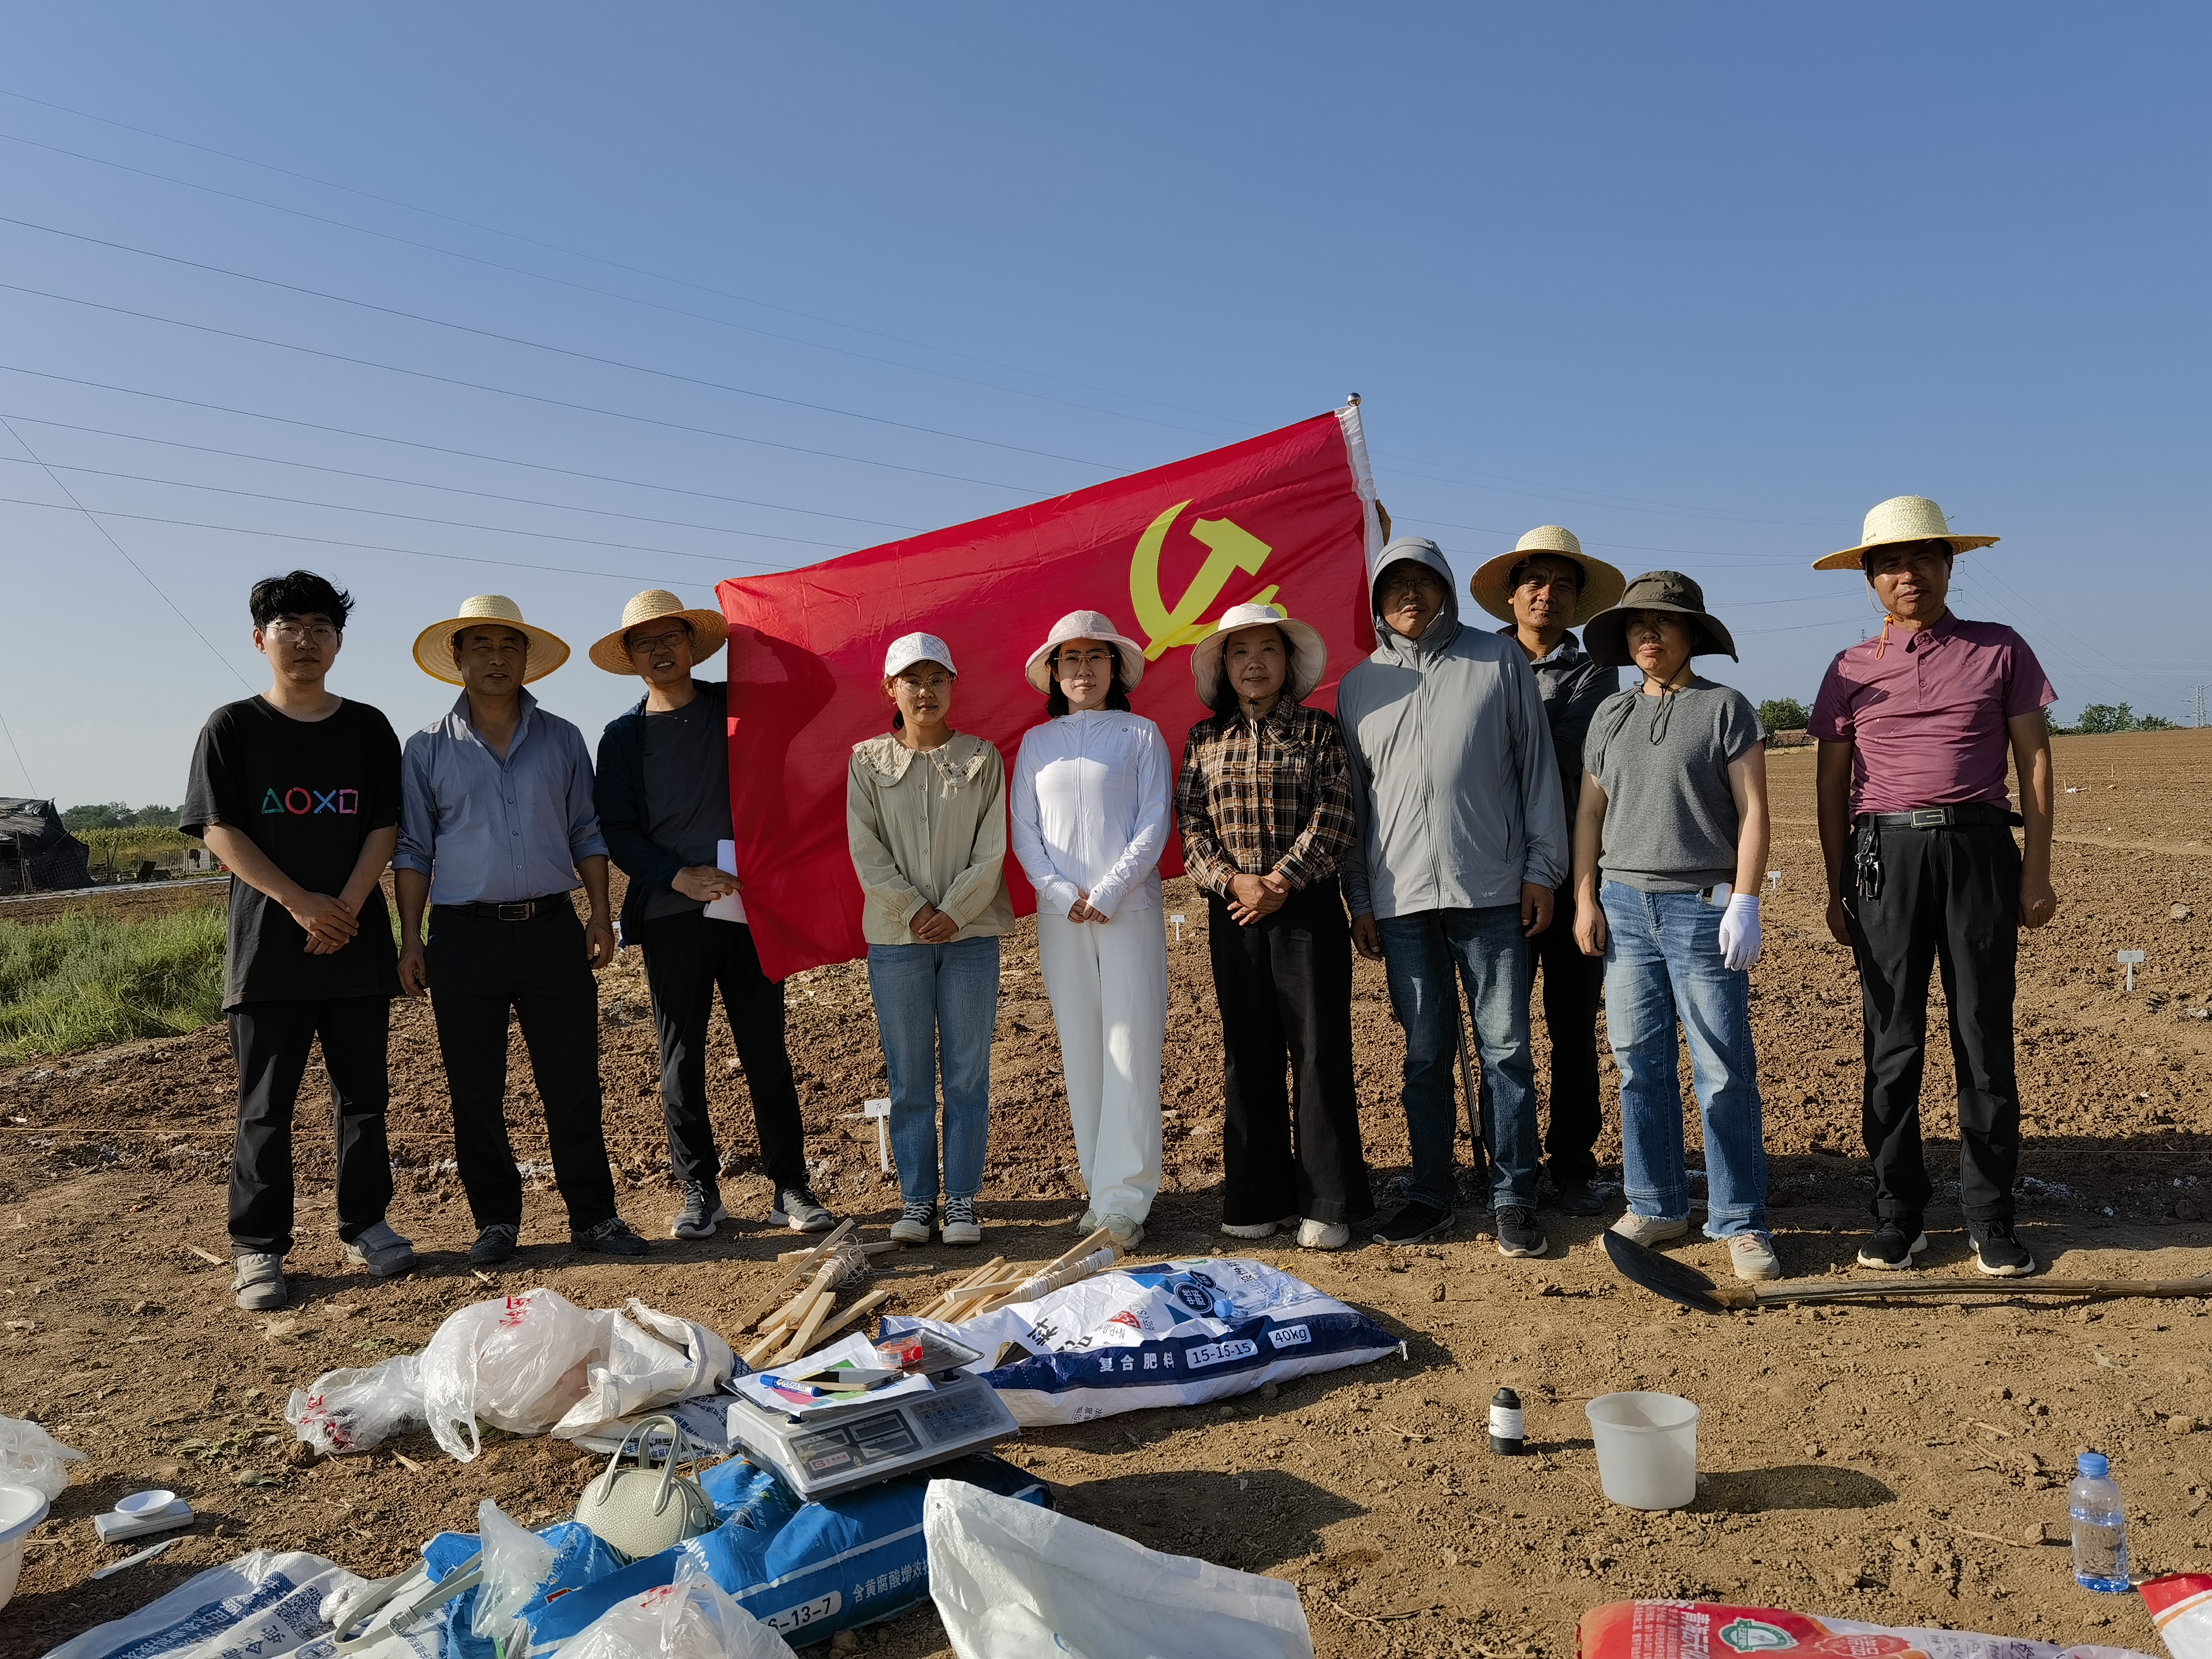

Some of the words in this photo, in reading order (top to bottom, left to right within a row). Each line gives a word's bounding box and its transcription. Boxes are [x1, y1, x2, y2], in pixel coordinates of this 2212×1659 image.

[1274, 1327, 1307, 1344] 40kg
[1098, 1351, 1175, 1373] 复合肥料
[1191, 1343, 1252, 1365] 15-15-15
